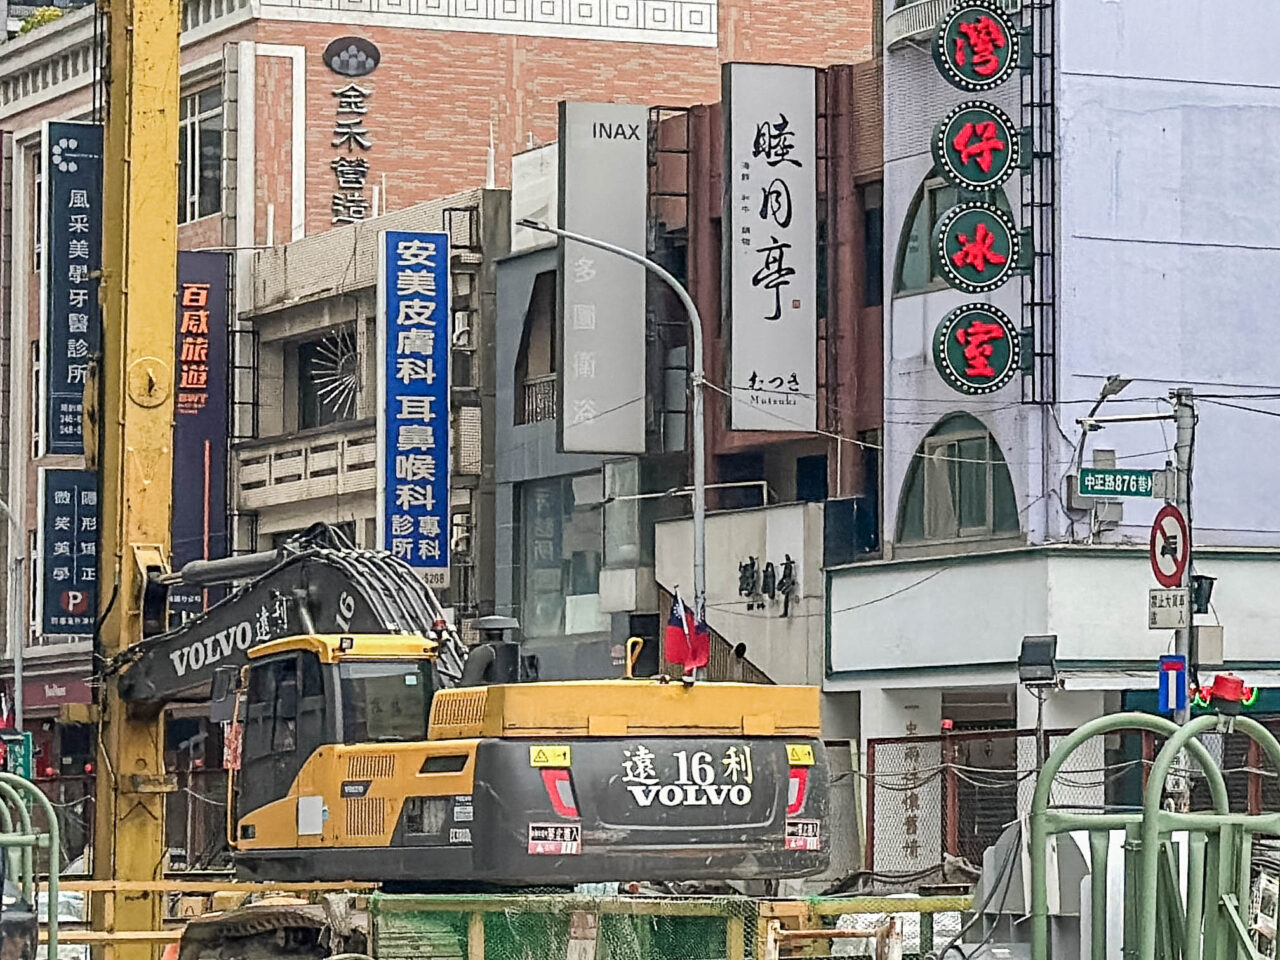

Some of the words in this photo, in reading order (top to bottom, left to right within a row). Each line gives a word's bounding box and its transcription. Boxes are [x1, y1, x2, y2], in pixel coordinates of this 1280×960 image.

[331, 82, 373, 226] 金禾營造
[593, 121, 641, 141] INAX
[752, 112, 803, 321] 睦月亭
[67, 190, 90, 384] 風采美學牙醫診所
[396, 239, 437, 385] 安美皮膚科
[179, 282, 211, 389] 百威旅遊
[748, 370, 800, 391] むつき
[395, 396, 437, 511] 耳鼻喉科
[392, 514, 414, 560] 診所
[418, 516, 441, 560] 專科
[68, 591, 82, 611] P
[335, 591, 355, 633] 16
[169, 621, 252, 677] VOLVO
[621, 745, 660, 785] 遠
[672, 750, 715, 786] 16
[722, 745, 753, 785] 利
[626, 784, 752, 807] VOLVO
